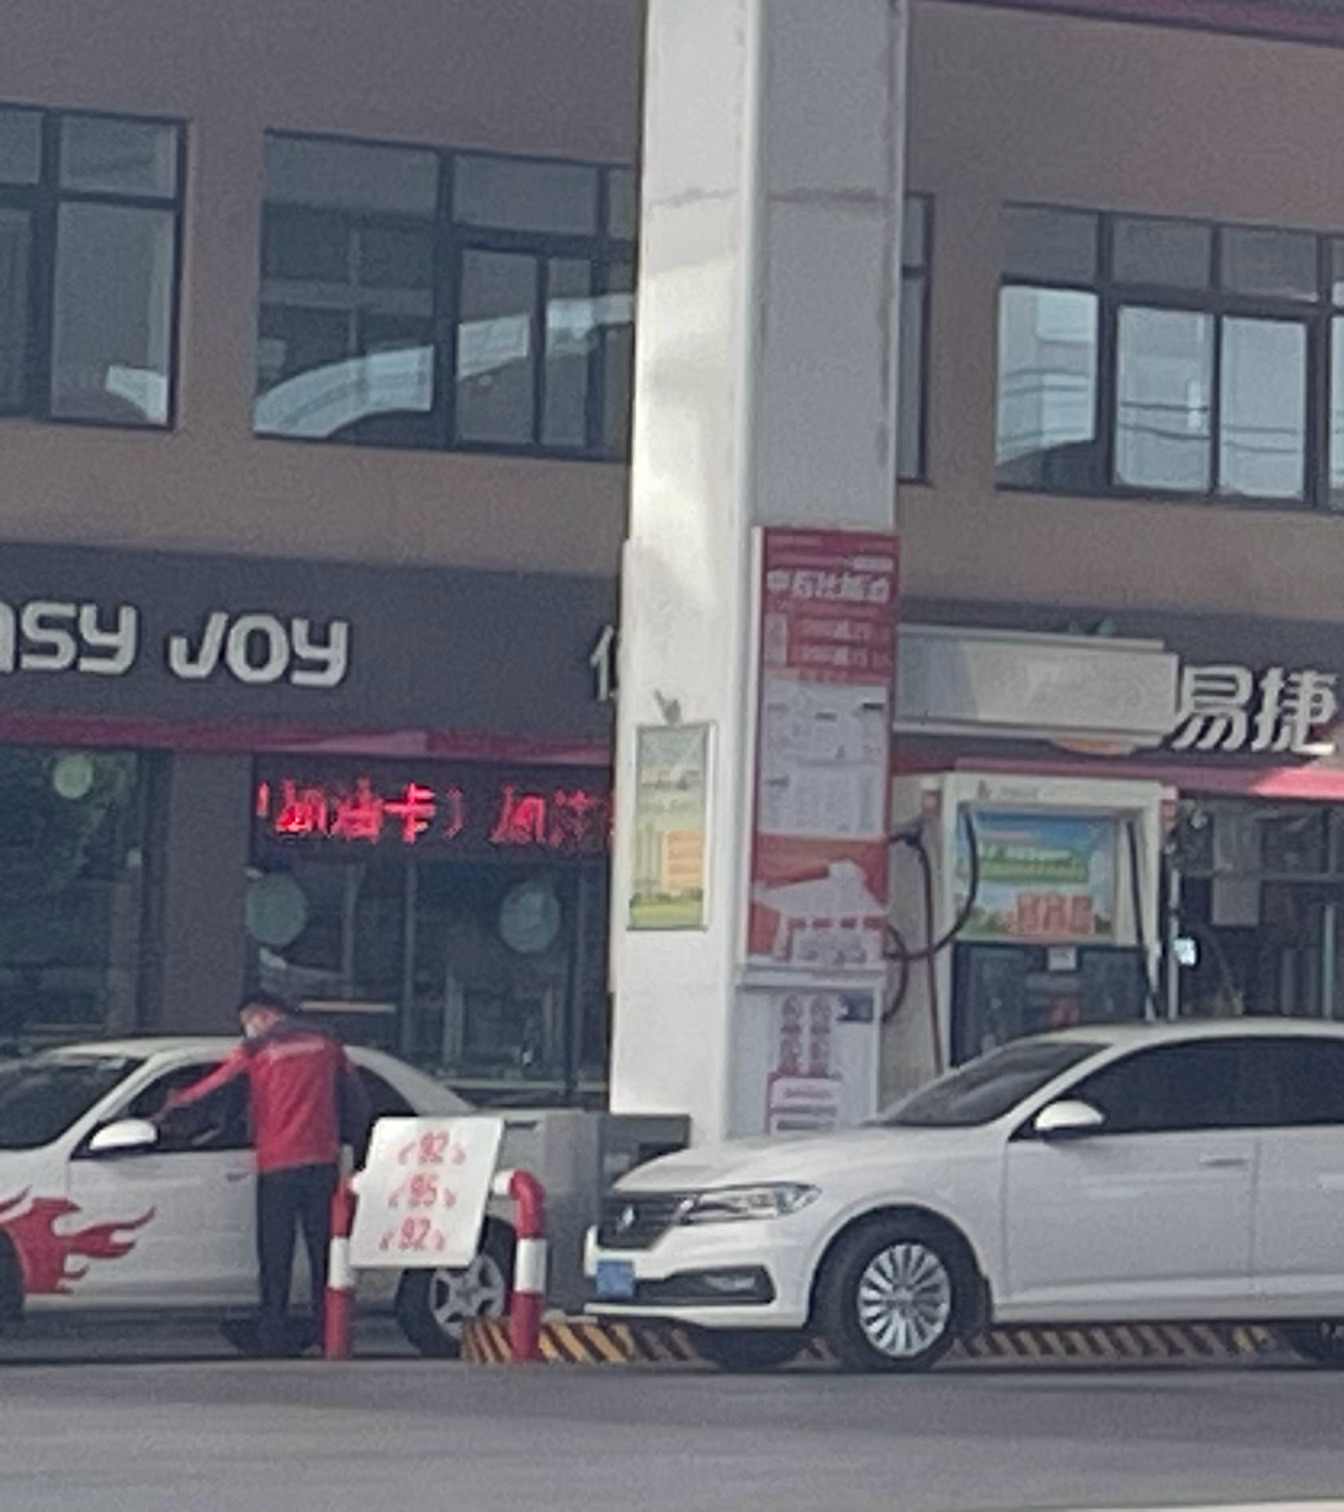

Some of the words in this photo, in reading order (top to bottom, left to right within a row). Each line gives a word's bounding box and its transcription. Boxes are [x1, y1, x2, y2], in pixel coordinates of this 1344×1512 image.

[0, 600, 138, 675] SY
[169, 611, 349, 687] JOY
[1170, 665, 1340, 755] 易捷
